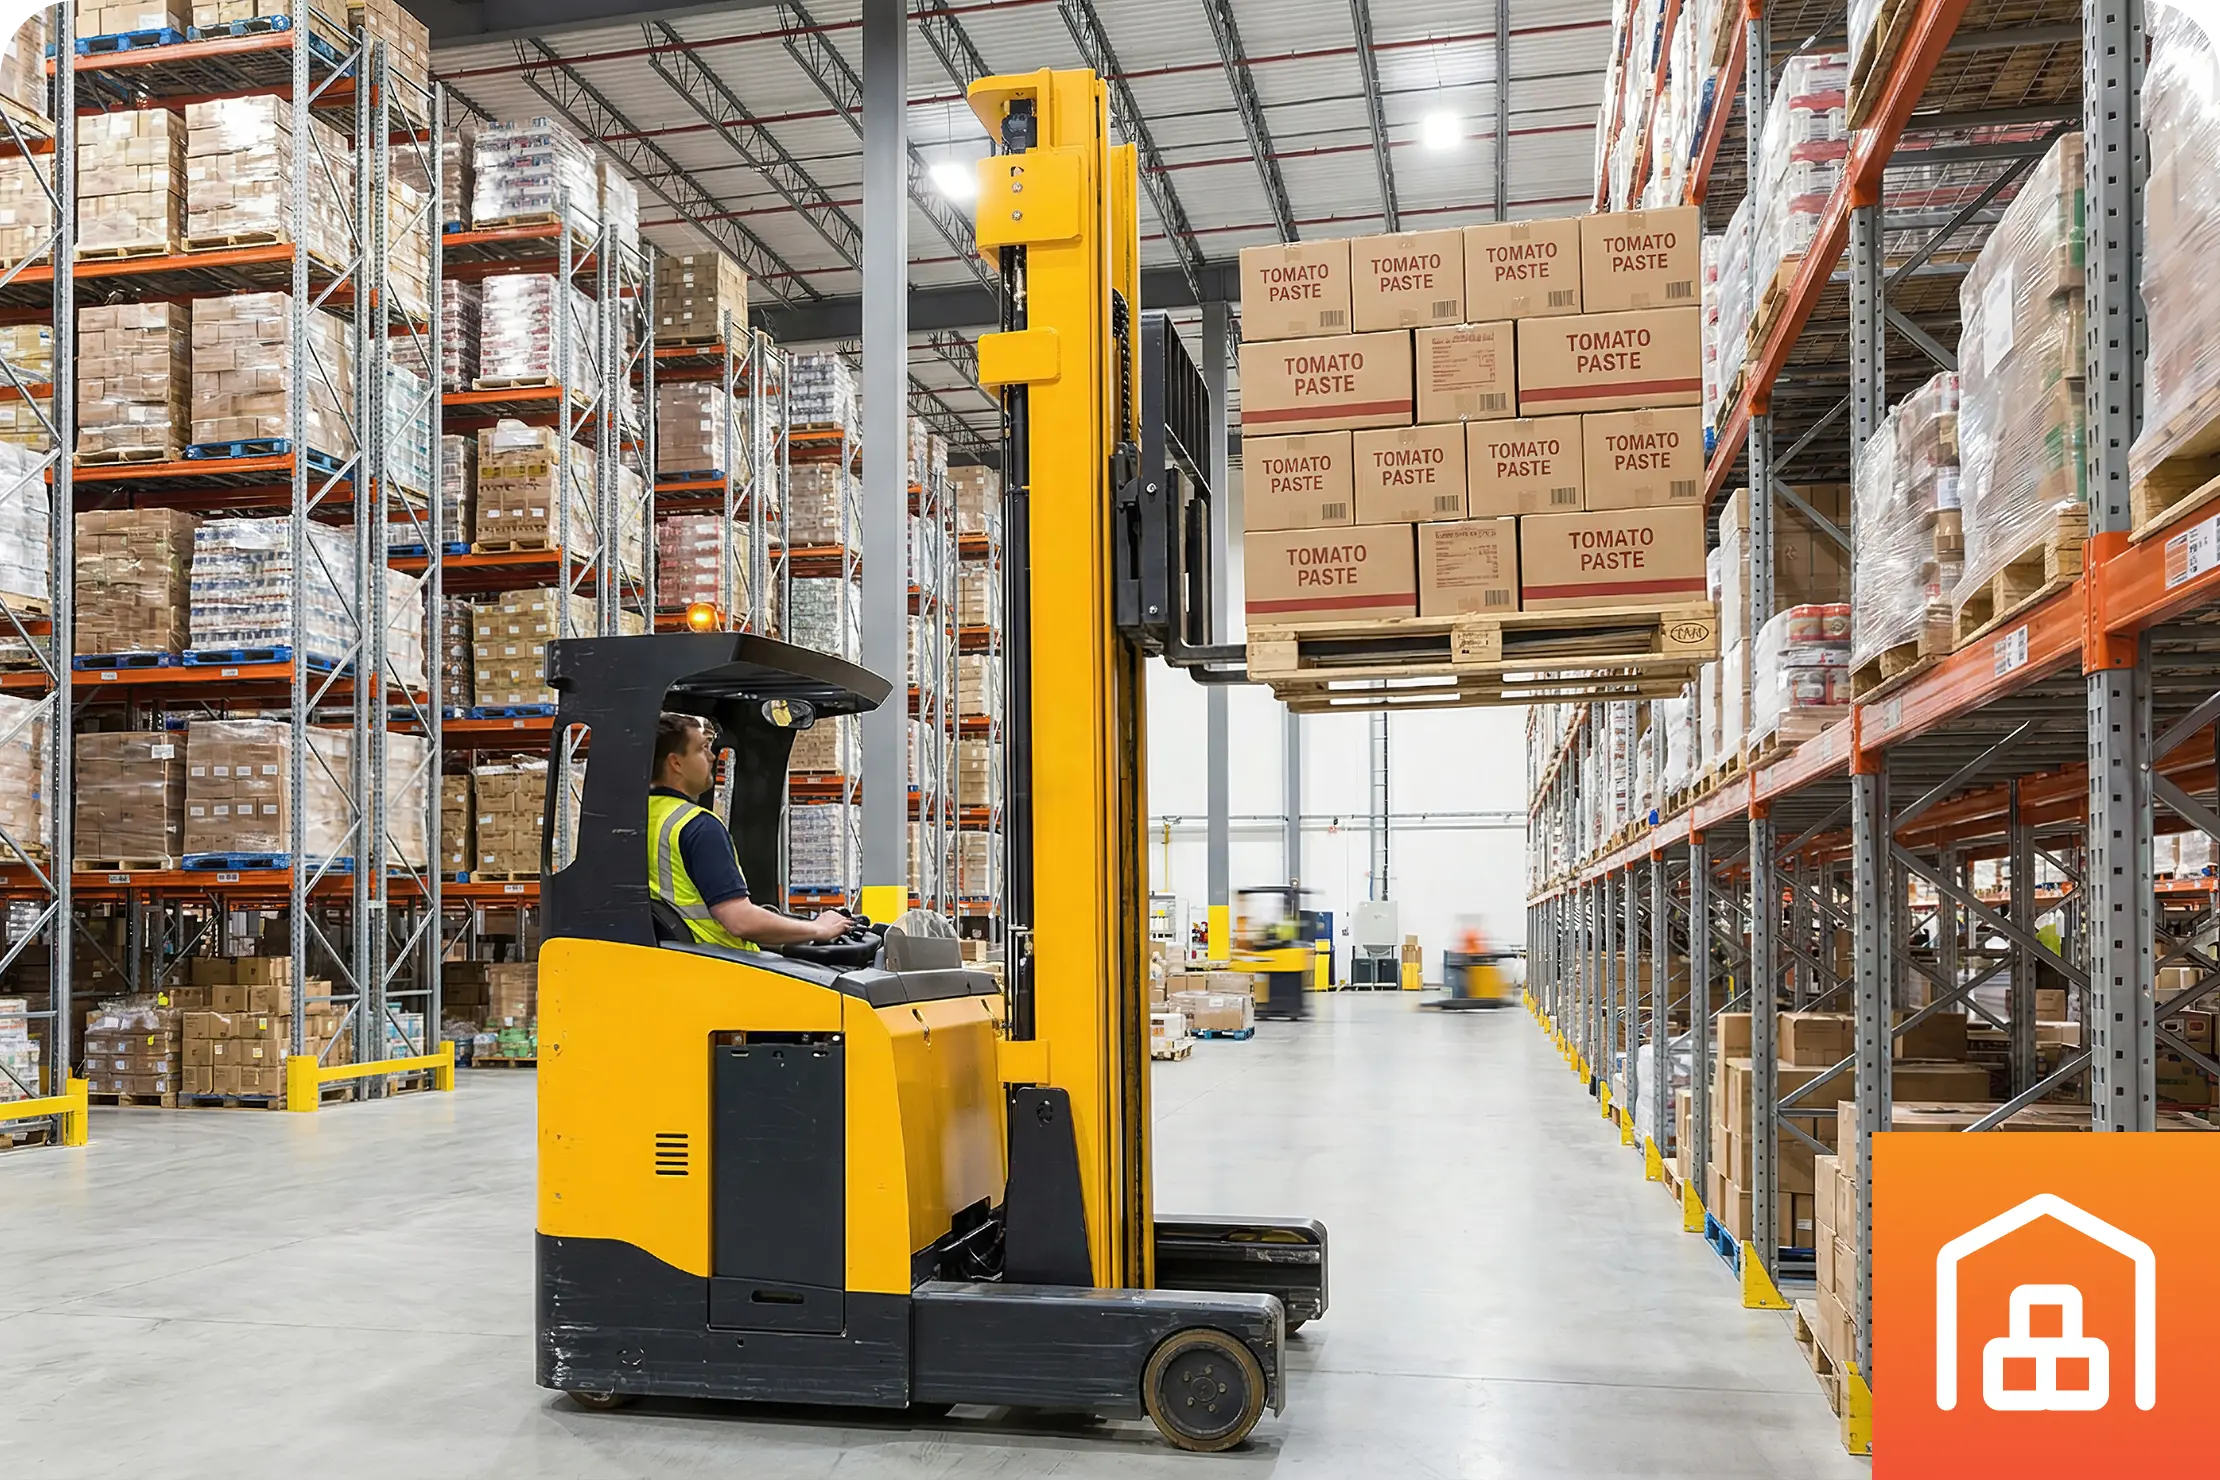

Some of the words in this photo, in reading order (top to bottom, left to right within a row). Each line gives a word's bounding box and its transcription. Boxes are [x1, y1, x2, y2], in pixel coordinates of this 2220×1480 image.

[1486, 243, 1557, 262] TOMATO
[1603, 233, 1676, 253] TOMATO
[1371, 254, 1440, 274] TOMATO
[1496, 263, 1549, 281] PASTE
[1613, 253, 1667, 272] PASTE
[1260, 264, 1328, 284] TOMATO
[1381, 274, 1433, 292] PASTE
[1270, 283, 1321, 301] PASTE
[1566, 329, 1650, 351] TOMATO
[1285, 353, 1363, 375] TOMATO
[1578, 352, 1641, 373] PASTE
[1295, 375, 1354, 396] PASTE
[1488, 440, 1559, 458] TOMATO
[1606, 432, 1679, 451] TOMATO
[1262, 456, 1331, 474] TOMATO
[1373, 448, 1443, 467] TOMATO
[1616, 452, 1670, 470] PASTE
[1383, 468, 1435, 485] PASTE
[1498, 460, 1551, 477] PASTE
[1272, 475, 1323, 493] PASTE
[1569, 528, 1653, 549] TOMATO
[1286, 545, 1366, 565] TOMATO
[1581, 551, 1644, 571] PASTE
[1299, 567, 1357, 586] PASTE
